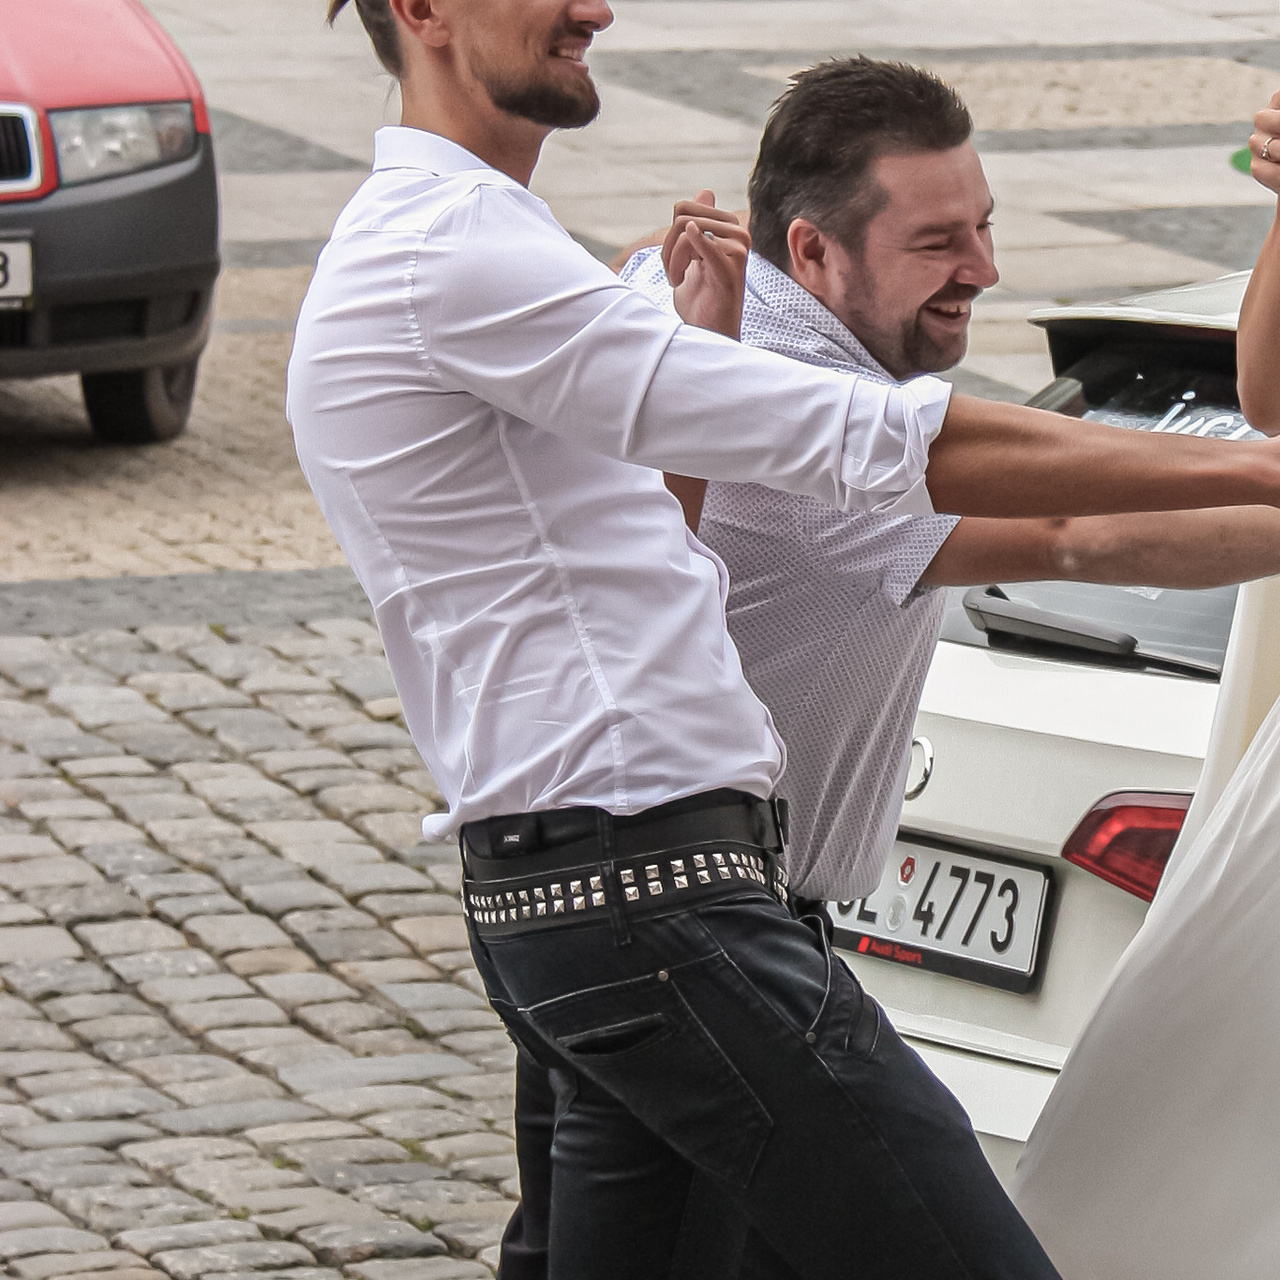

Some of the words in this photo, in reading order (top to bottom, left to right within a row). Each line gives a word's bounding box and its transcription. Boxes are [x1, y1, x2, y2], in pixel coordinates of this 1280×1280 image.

[912, 861, 1019, 953] 4773
[870, 939, 892, 957] Audi
[894, 943, 922, 964] Sport
